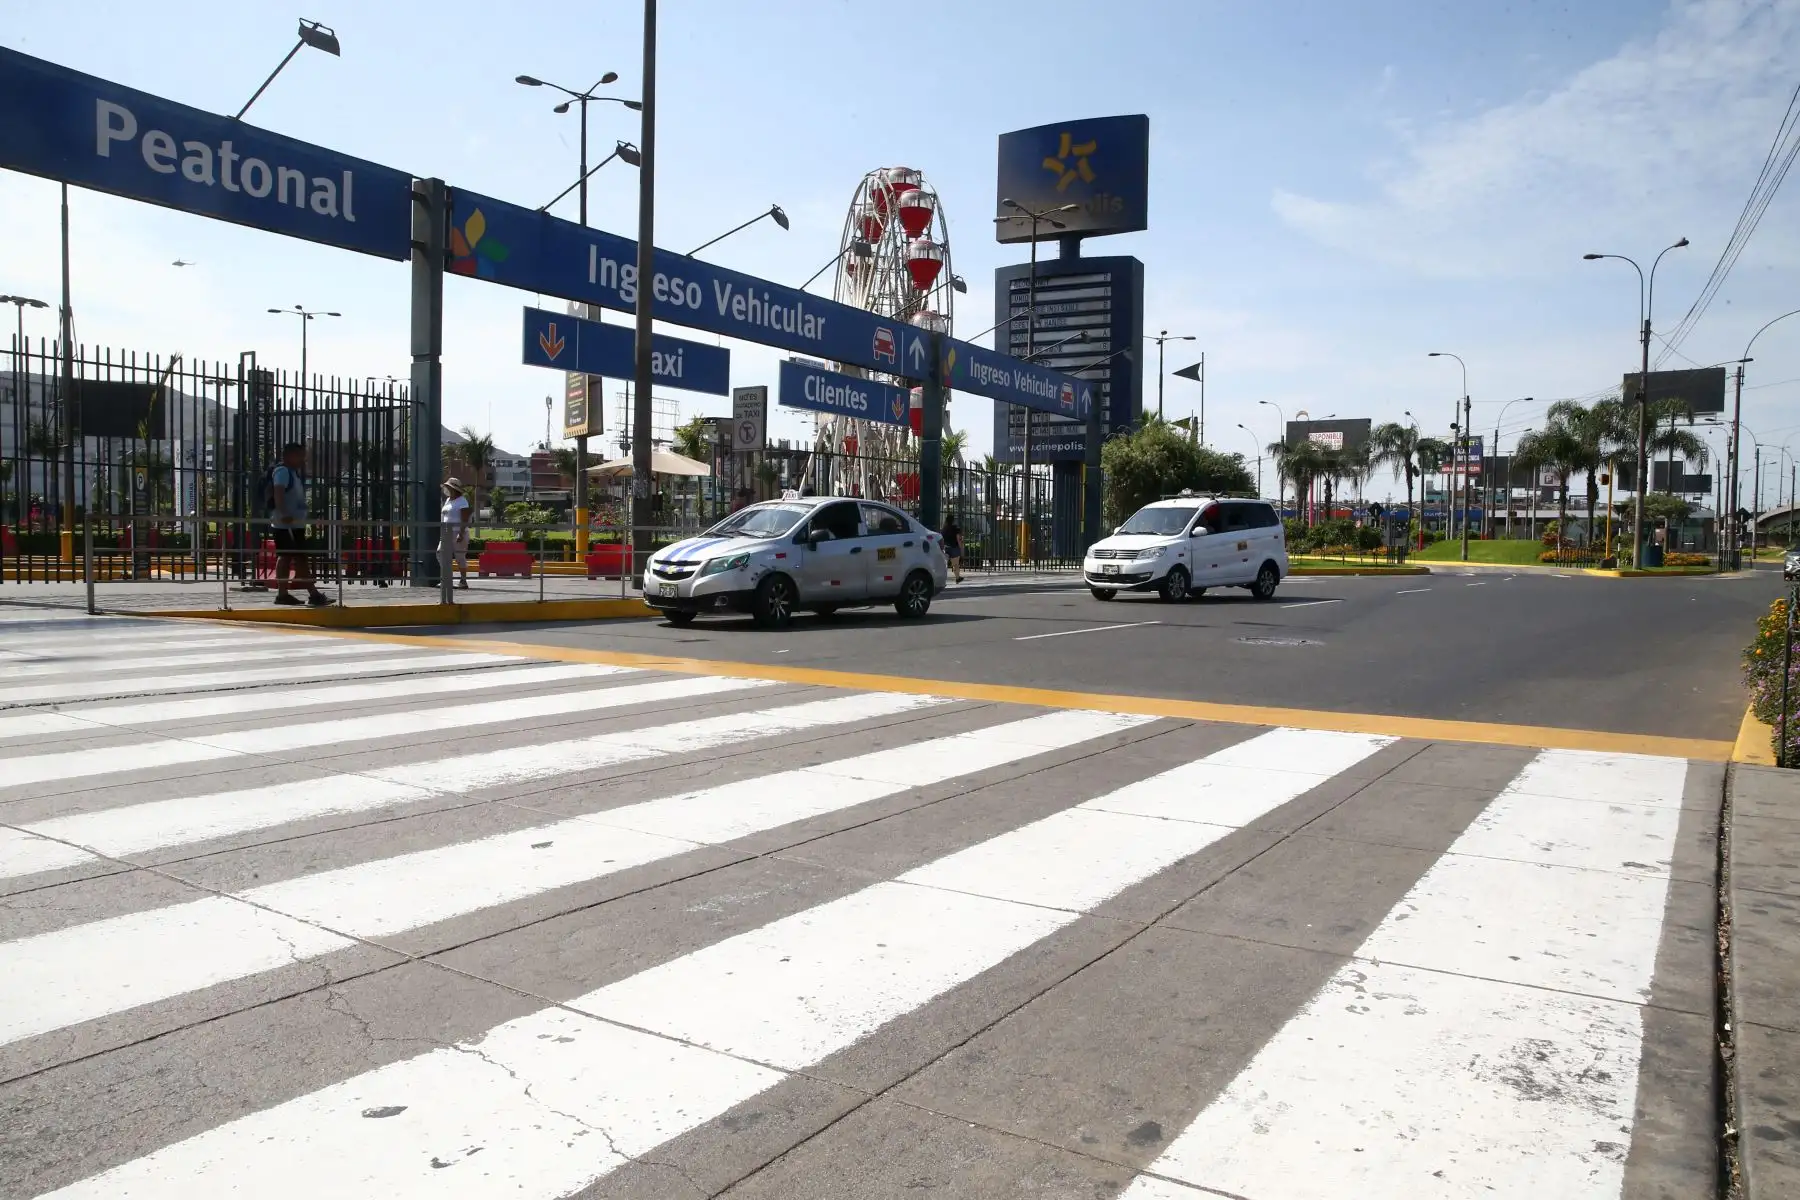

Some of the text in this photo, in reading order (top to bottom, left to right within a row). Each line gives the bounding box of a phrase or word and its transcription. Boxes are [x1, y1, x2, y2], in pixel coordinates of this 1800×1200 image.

[95, 98, 356, 222] Peatonal
[588, 244, 827, 341] Ingeso Vehicular
[651, 349, 683, 378] axi
[970, 356, 1058, 399] Ingreso Vehicular
[804, 374, 868, 411] Clientes
[743, 410, 760, 418] TAXI
